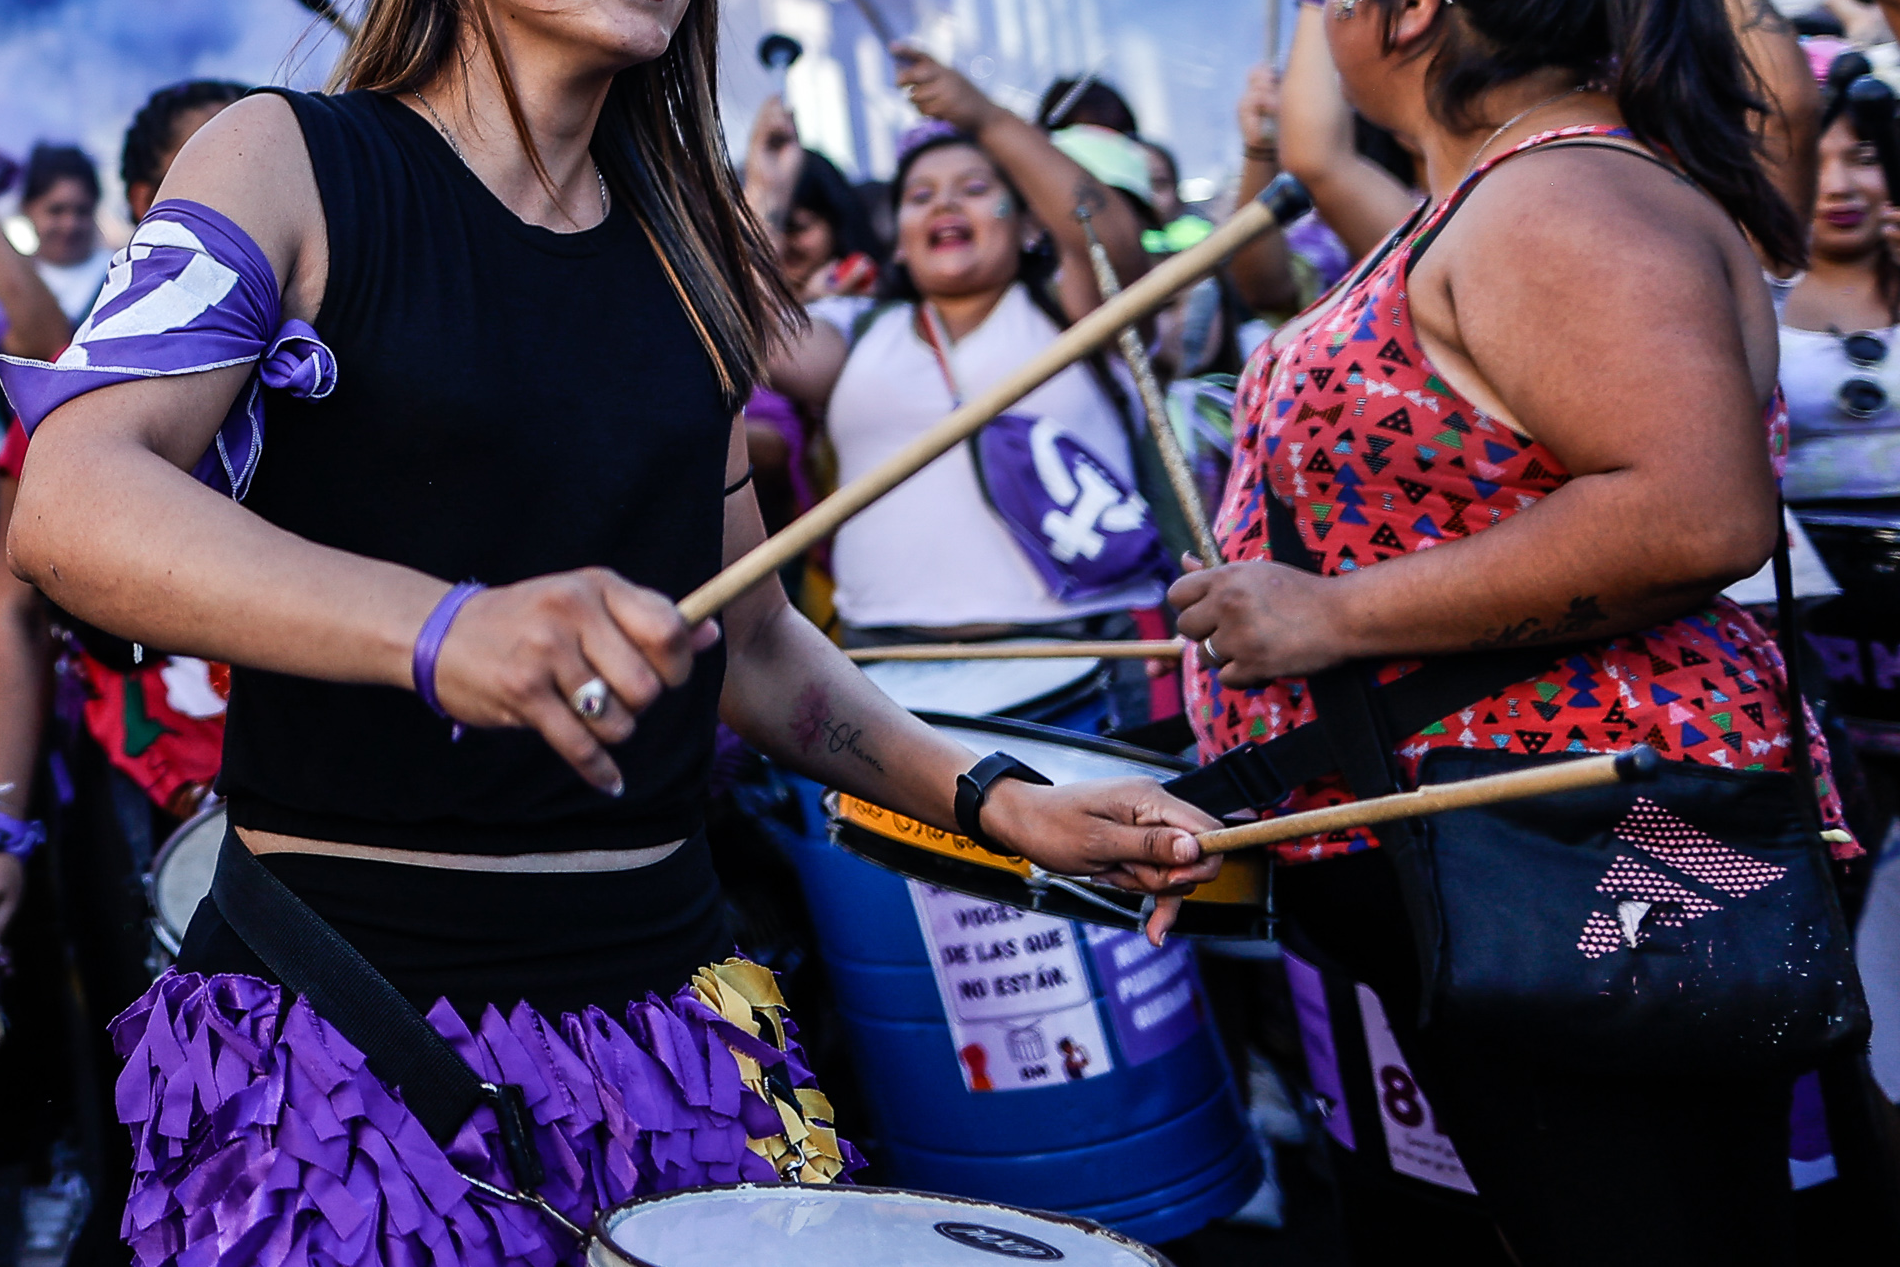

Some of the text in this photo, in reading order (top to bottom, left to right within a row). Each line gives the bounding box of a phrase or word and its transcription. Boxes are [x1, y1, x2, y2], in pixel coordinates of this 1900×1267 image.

[942, 928, 1064, 965] DE LAS QUE
[958, 978, 988, 1001] NO
